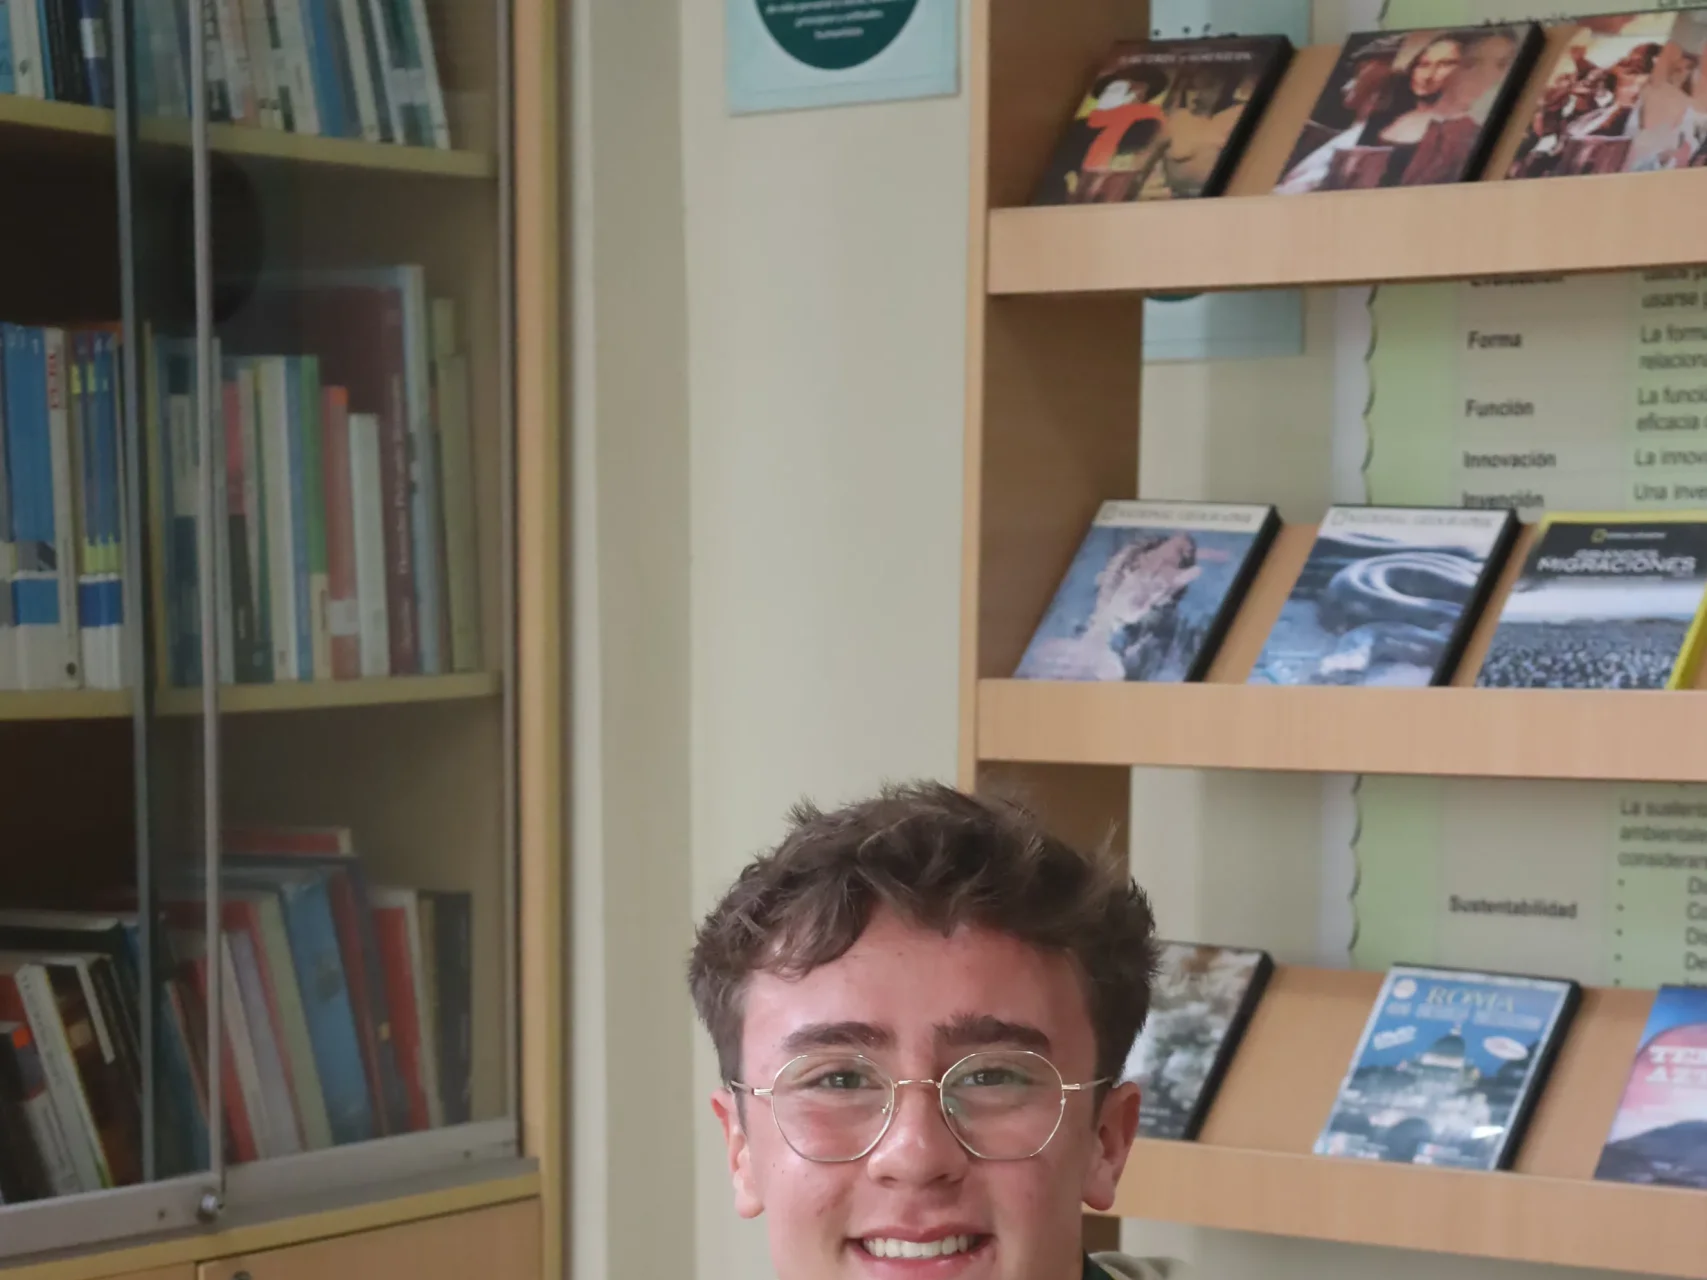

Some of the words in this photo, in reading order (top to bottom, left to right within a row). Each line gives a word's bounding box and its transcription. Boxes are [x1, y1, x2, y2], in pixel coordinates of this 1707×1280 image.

[1467, 330, 1522, 350] Forma
[1640, 324, 1662, 343] La
[1637, 386, 1659, 406] La
[1465, 398, 1534, 417] Función
[1463, 449, 1556, 468] Innovación
[1634, 447, 1656, 467] La
[1462, 489, 1544, 508] Invención
[1536, 556, 1697, 574] MIGRACIONES
[1449, 894, 1578, 919] Sustentabilidad
[1427, 986, 1515, 1013] ROMA
